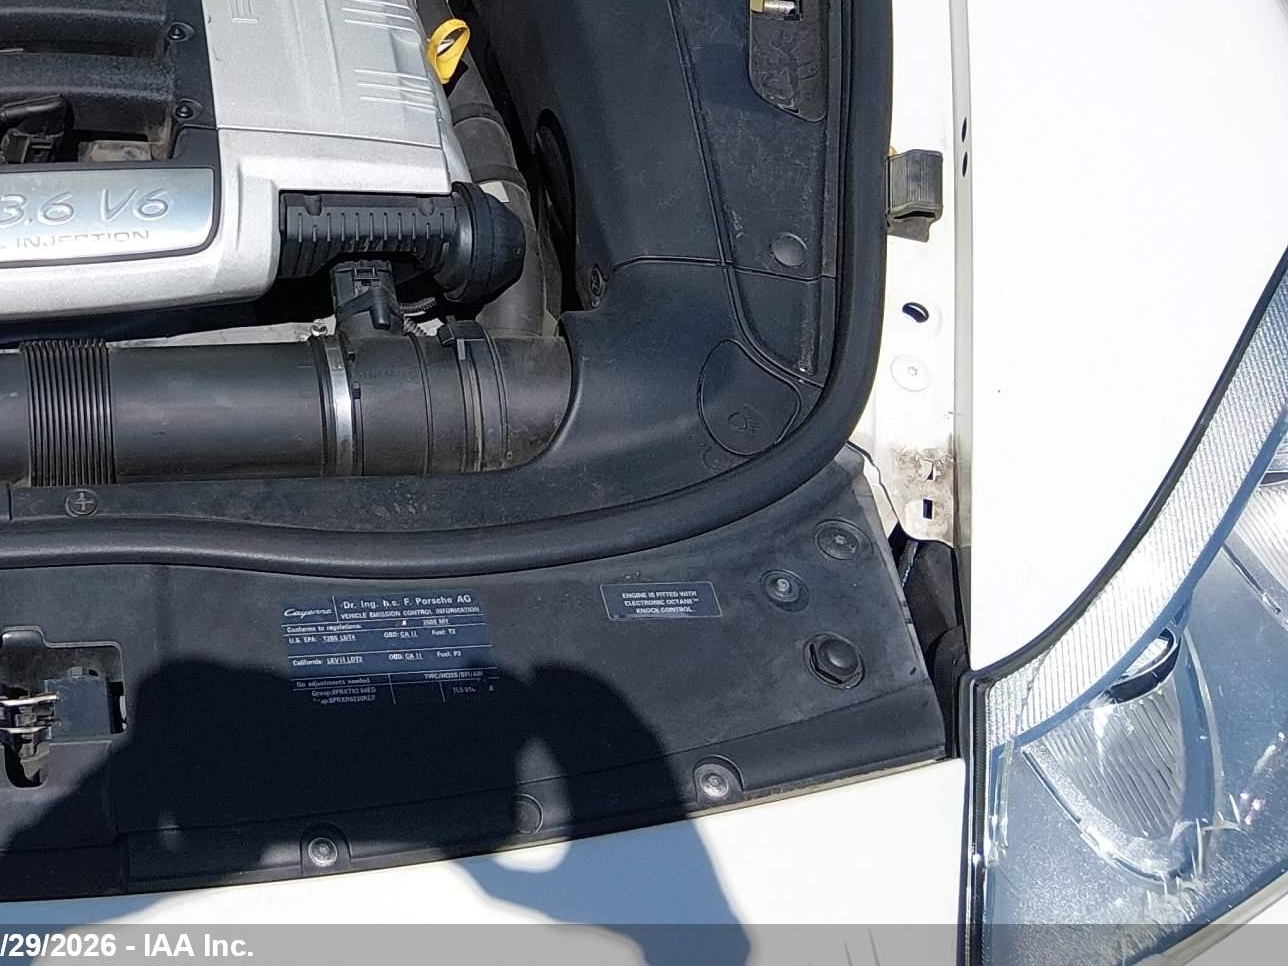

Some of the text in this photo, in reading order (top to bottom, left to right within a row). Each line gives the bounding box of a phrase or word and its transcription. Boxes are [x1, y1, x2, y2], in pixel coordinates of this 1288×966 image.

[100, 185, 170, 222] V6
[415, 596, 453, 605] Porsche
[457, 595, 472, 603] AG
